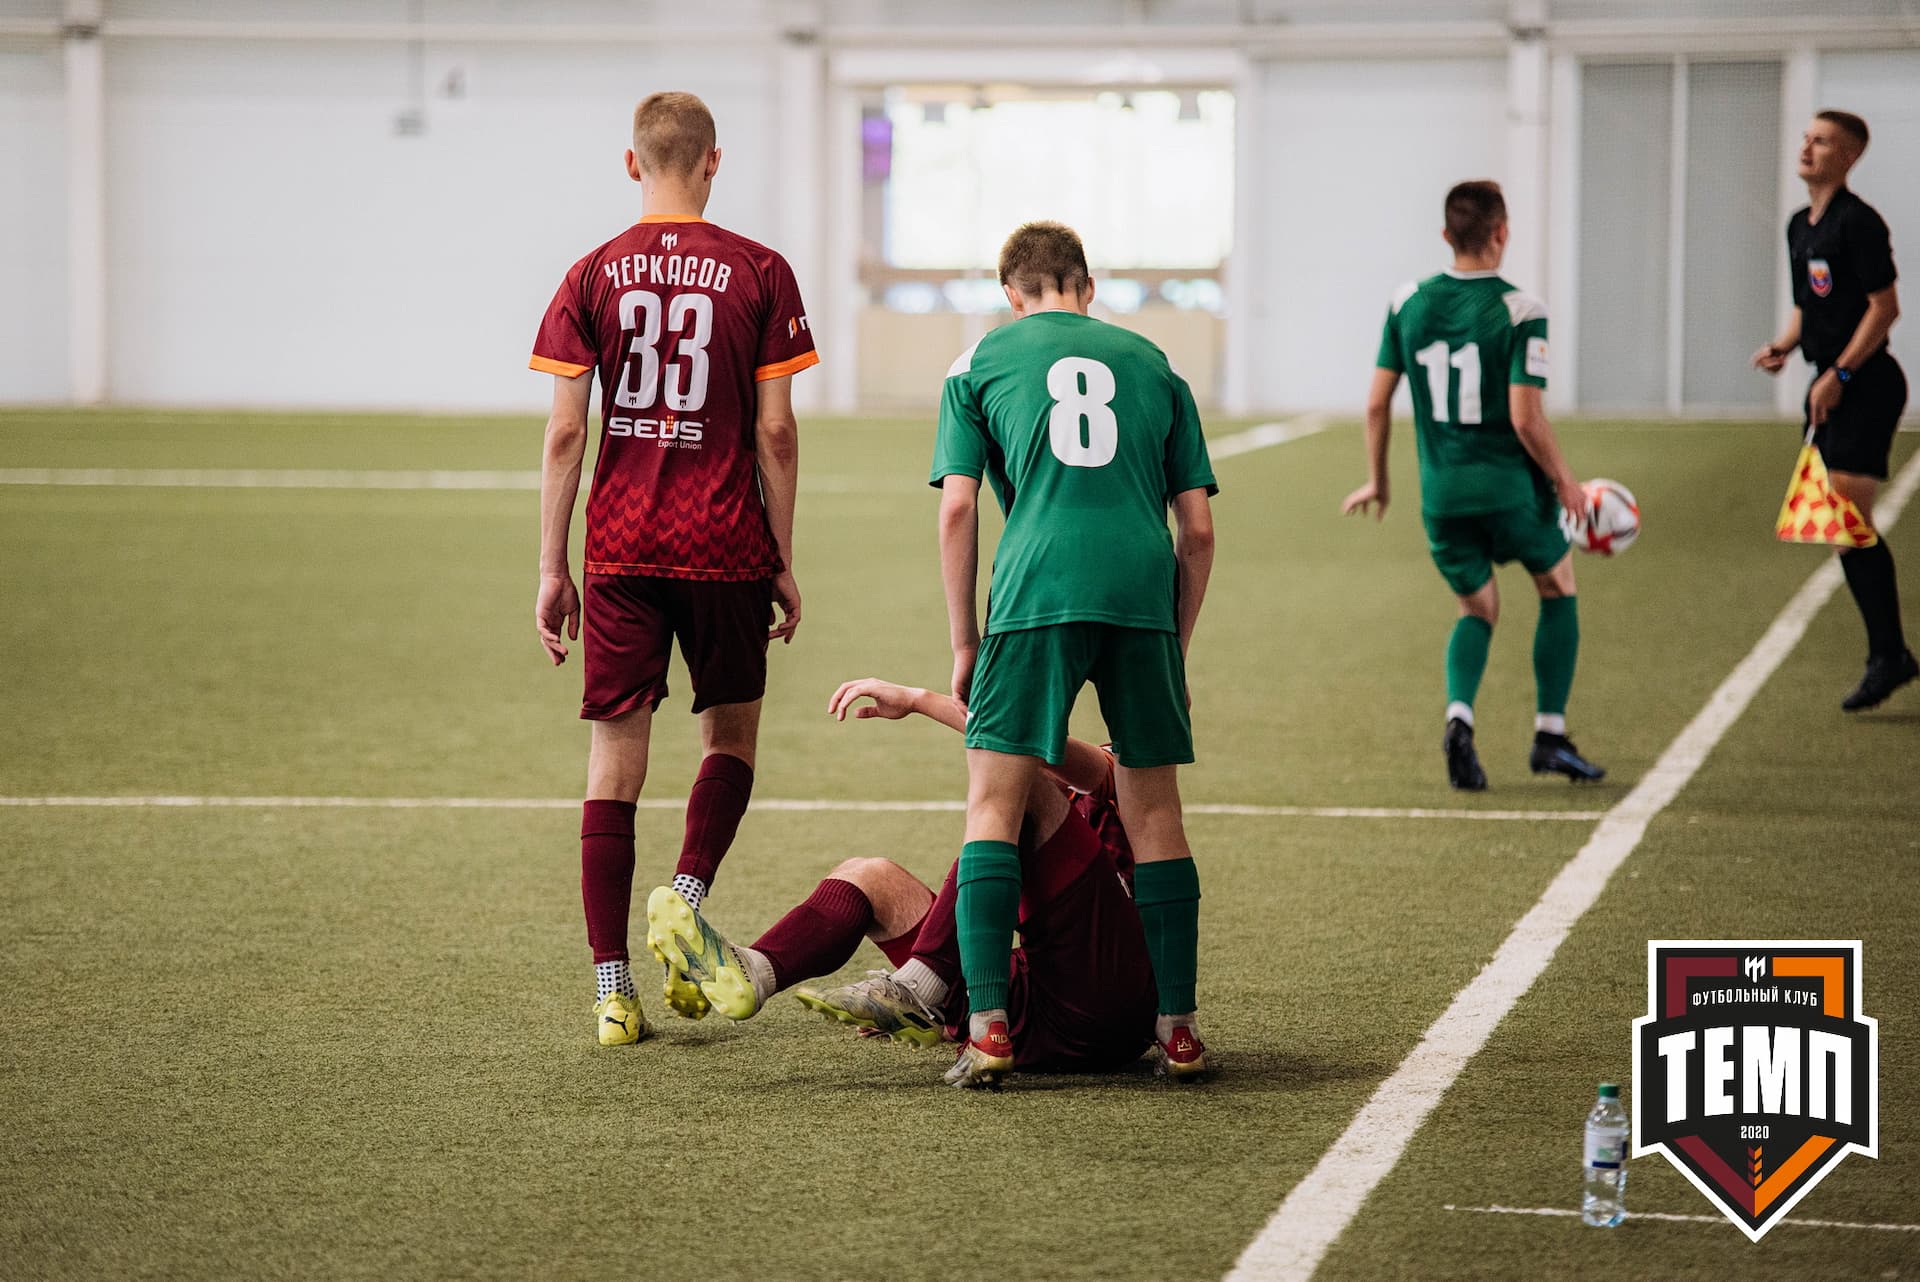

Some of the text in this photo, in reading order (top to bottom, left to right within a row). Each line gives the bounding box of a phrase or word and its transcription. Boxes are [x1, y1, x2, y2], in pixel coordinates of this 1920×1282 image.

[604, 254, 732, 293] ЧЕРКАСОВ
[614, 290, 713, 411] 33
[1415, 340, 1482, 424] 11
[658, 439, 702, 450] Export Union
[1046, 356, 1118, 467] 8
